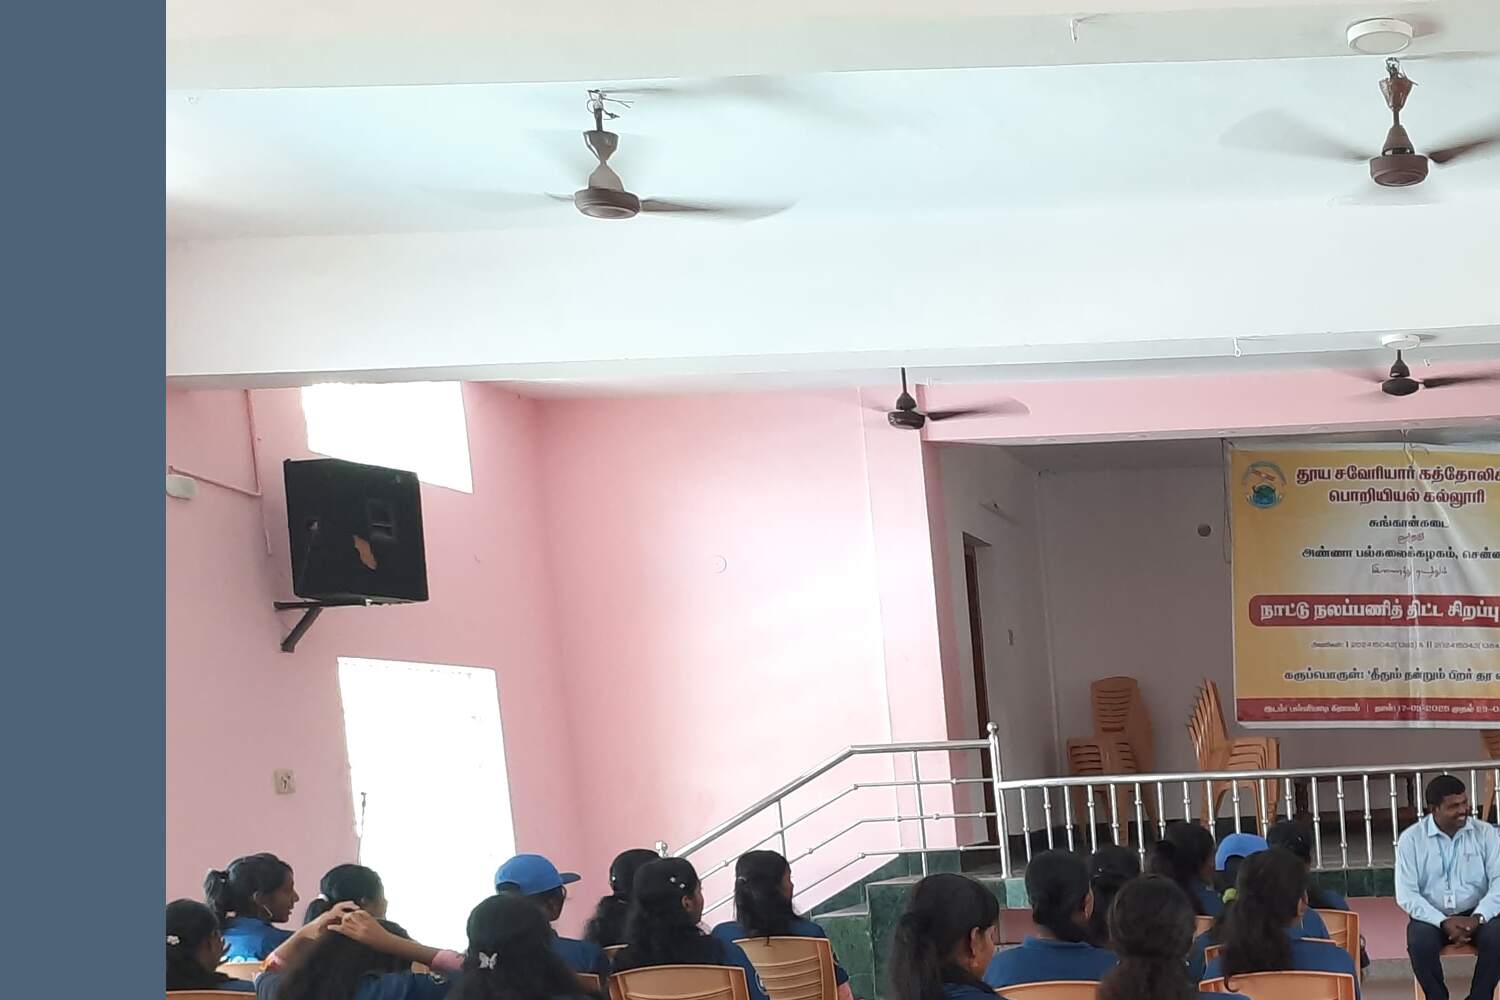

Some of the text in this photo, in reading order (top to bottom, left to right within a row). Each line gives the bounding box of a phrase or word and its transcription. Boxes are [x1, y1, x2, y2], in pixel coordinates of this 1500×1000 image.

[1297, 467, 1330, 483] தூய
[1335, 465, 1415, 482] சவேரியார்
[1329, 488, 1484, 507] பொறியியல் கல்லூரி
[1302, 545, 1352, 558] அண்ணா
[1356, 545, 1458, 561] பல்கலைக்கழகம்,
[1260, 602, 1309, 620] நாட்டு
[1314, 598, 1402, 620] நலப்பணித்
[1407, 600, 1443, 620] திட்ட
[1448, 600, 1499, 622] சிறப்பு
[1404, 667, 1445, 682] நன்றும்
